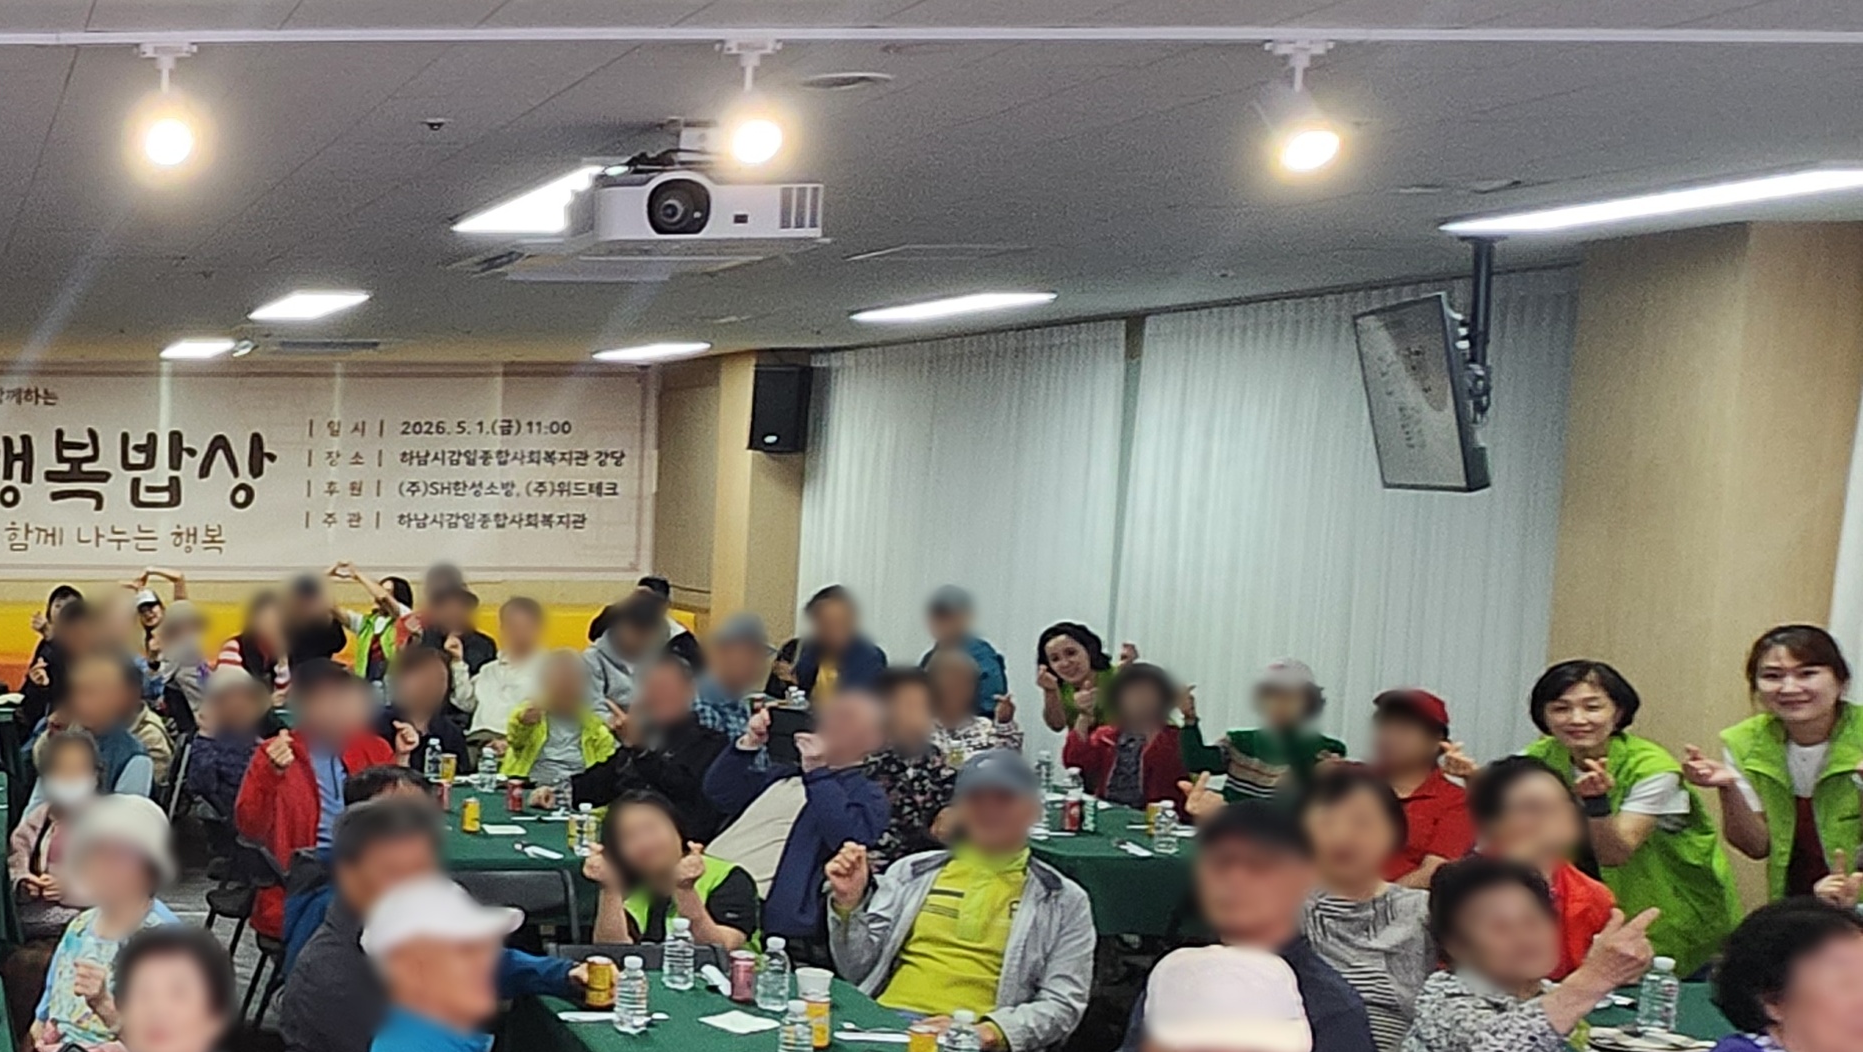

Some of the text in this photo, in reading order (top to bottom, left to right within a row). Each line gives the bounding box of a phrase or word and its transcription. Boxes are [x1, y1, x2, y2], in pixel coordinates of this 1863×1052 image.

[526, 420, 573, 435] 11:00
[398, 448, 590, 468] 하남시감일종합사회복지관
[593, 448, 627, 468] 강당
[525, 479, 620, 498] (주)위드테크
[396, 511, 588, 530] 하남시감일종합사회복지관
[4, 520, 64, 552] 함께
[77, 524, 158, 552] 나누는
[171, 522, 227, 554] 행복
